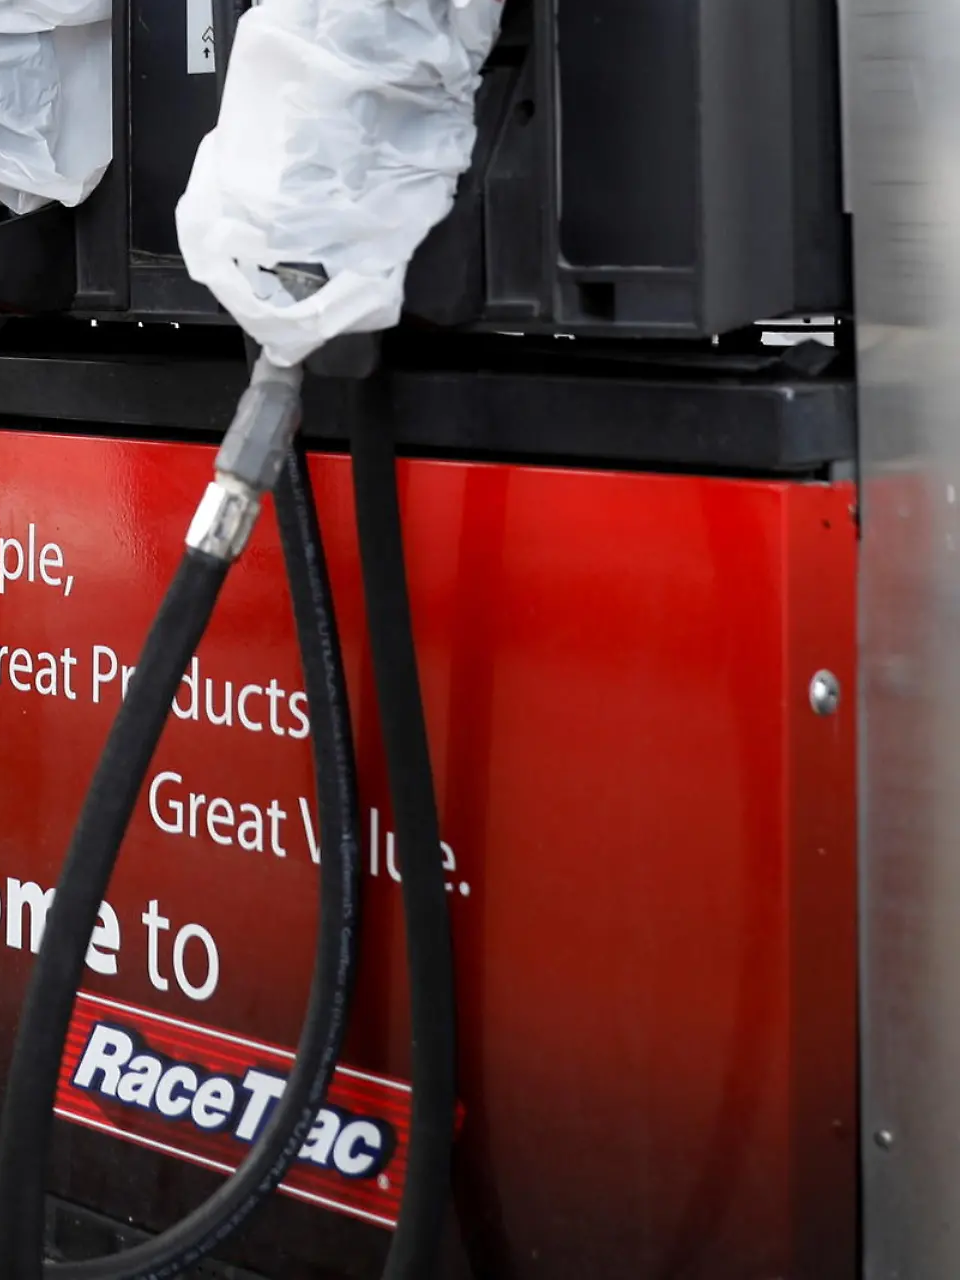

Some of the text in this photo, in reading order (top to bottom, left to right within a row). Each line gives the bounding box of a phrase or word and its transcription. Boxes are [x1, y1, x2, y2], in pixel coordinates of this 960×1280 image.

[92, 644, 311, 739] Prducts
[148, 770, 288, 858] Great
[141, 898, 220, 1002] to
[73, 1023, 383, 1175] RaceTac
